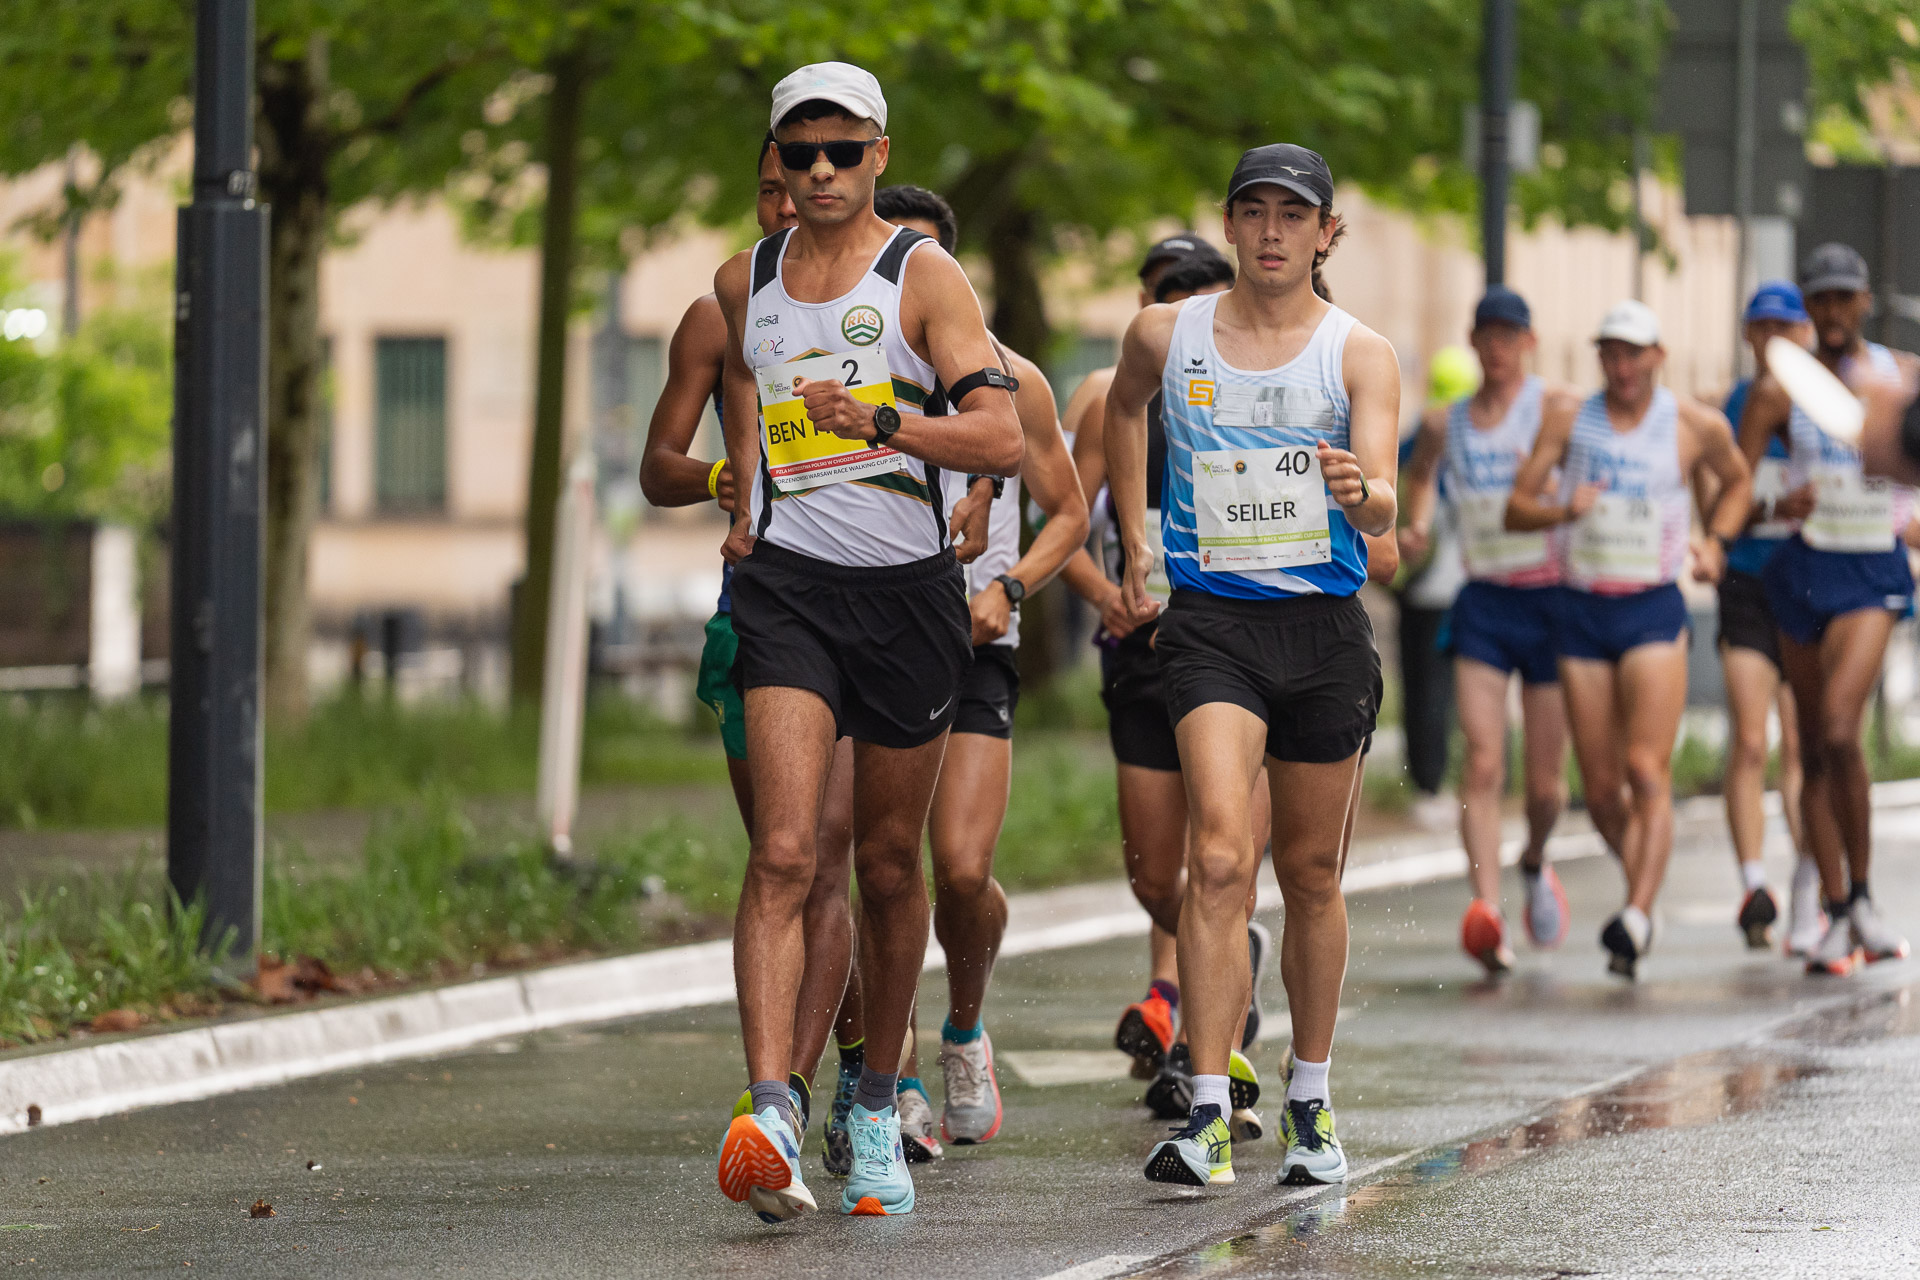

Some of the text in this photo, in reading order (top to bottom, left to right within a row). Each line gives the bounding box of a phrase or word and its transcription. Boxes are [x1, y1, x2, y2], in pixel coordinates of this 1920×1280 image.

[847, 311, 877, 328] RKS
[841, 358, 863, 387] 2
[1184, 367, 1208, 375] erima
[768, 418, 806, 445] BEN
[833, 466, 848, 475] RACE
[849, 461, 876, 472] WALKING
[876, 458, 889, 466] CUP
[889, 455, 903, 464] 2025
[1275, 450, 1311, 477] 40
[1226, 501, 1297, 523] SEILER
